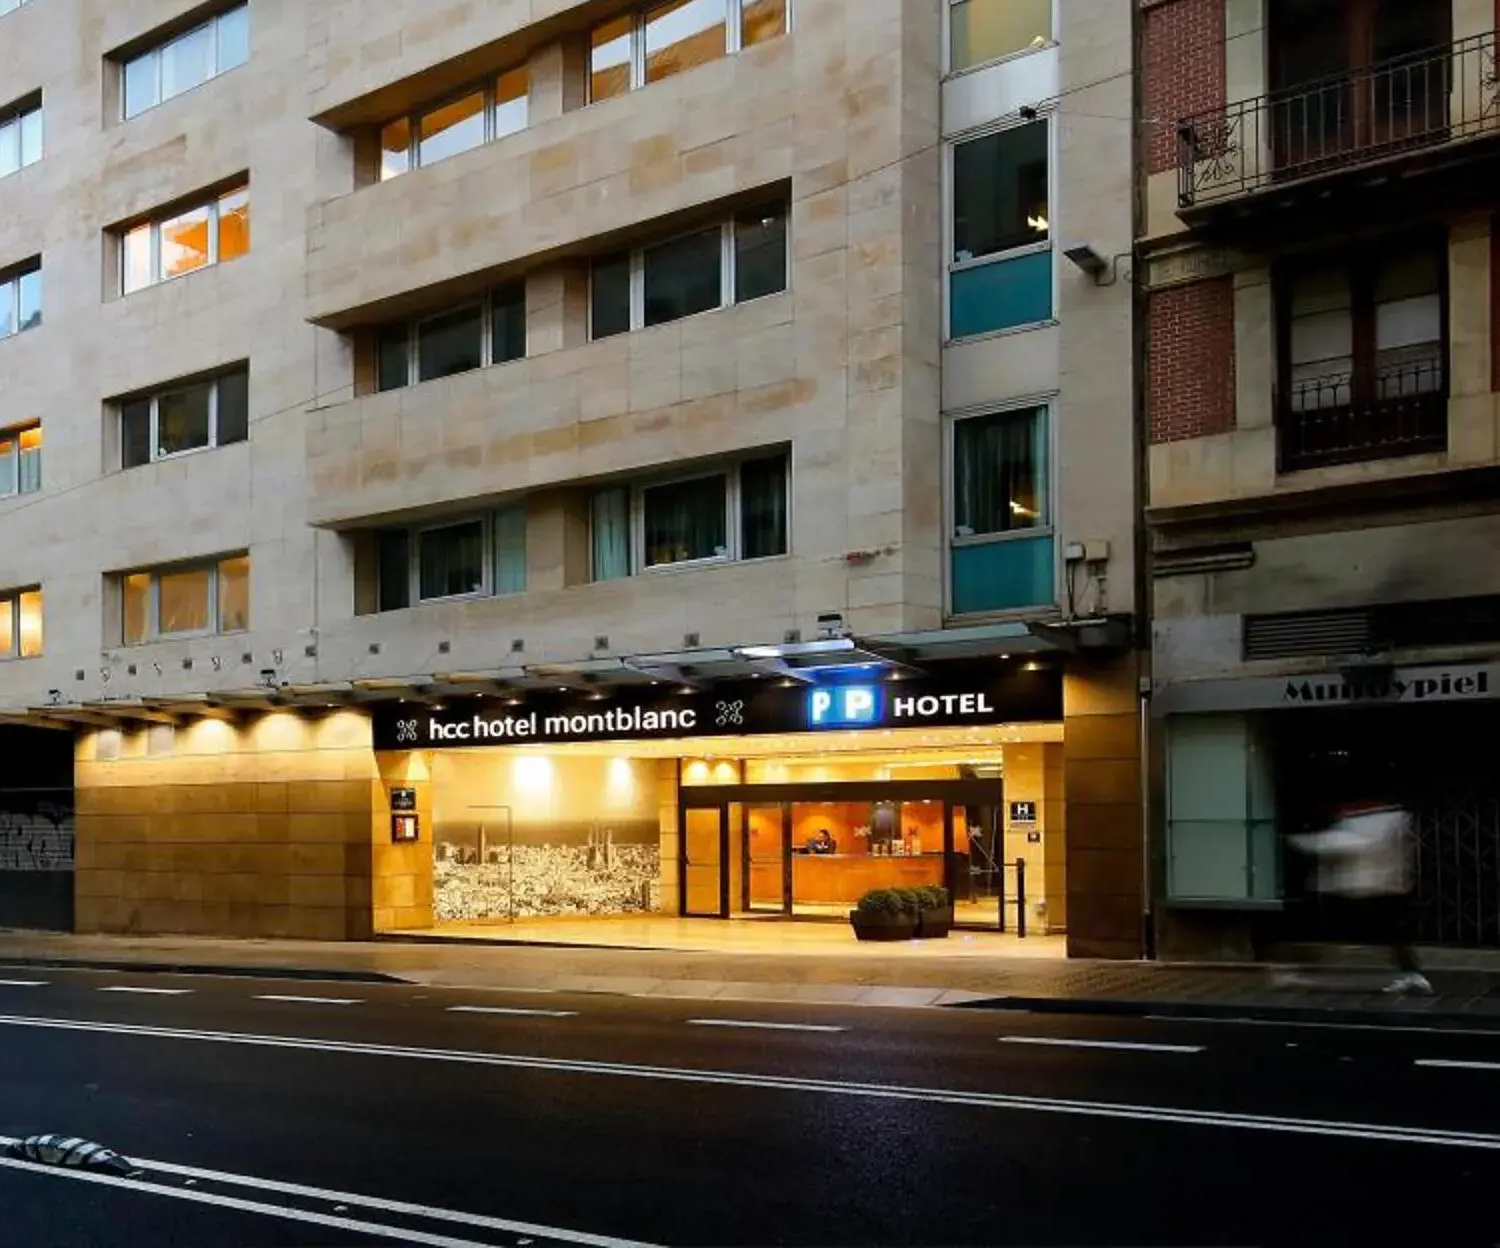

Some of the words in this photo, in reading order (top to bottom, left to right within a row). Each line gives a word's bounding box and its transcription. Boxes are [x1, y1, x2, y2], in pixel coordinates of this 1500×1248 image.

[811, 690, 832, 722] P
[845, 689, 874, 720] P
[893, 692, 994, 718] HOTEL
[544, 705, 697, 735] montblanc
[1017, 803, 1028, 815] H
